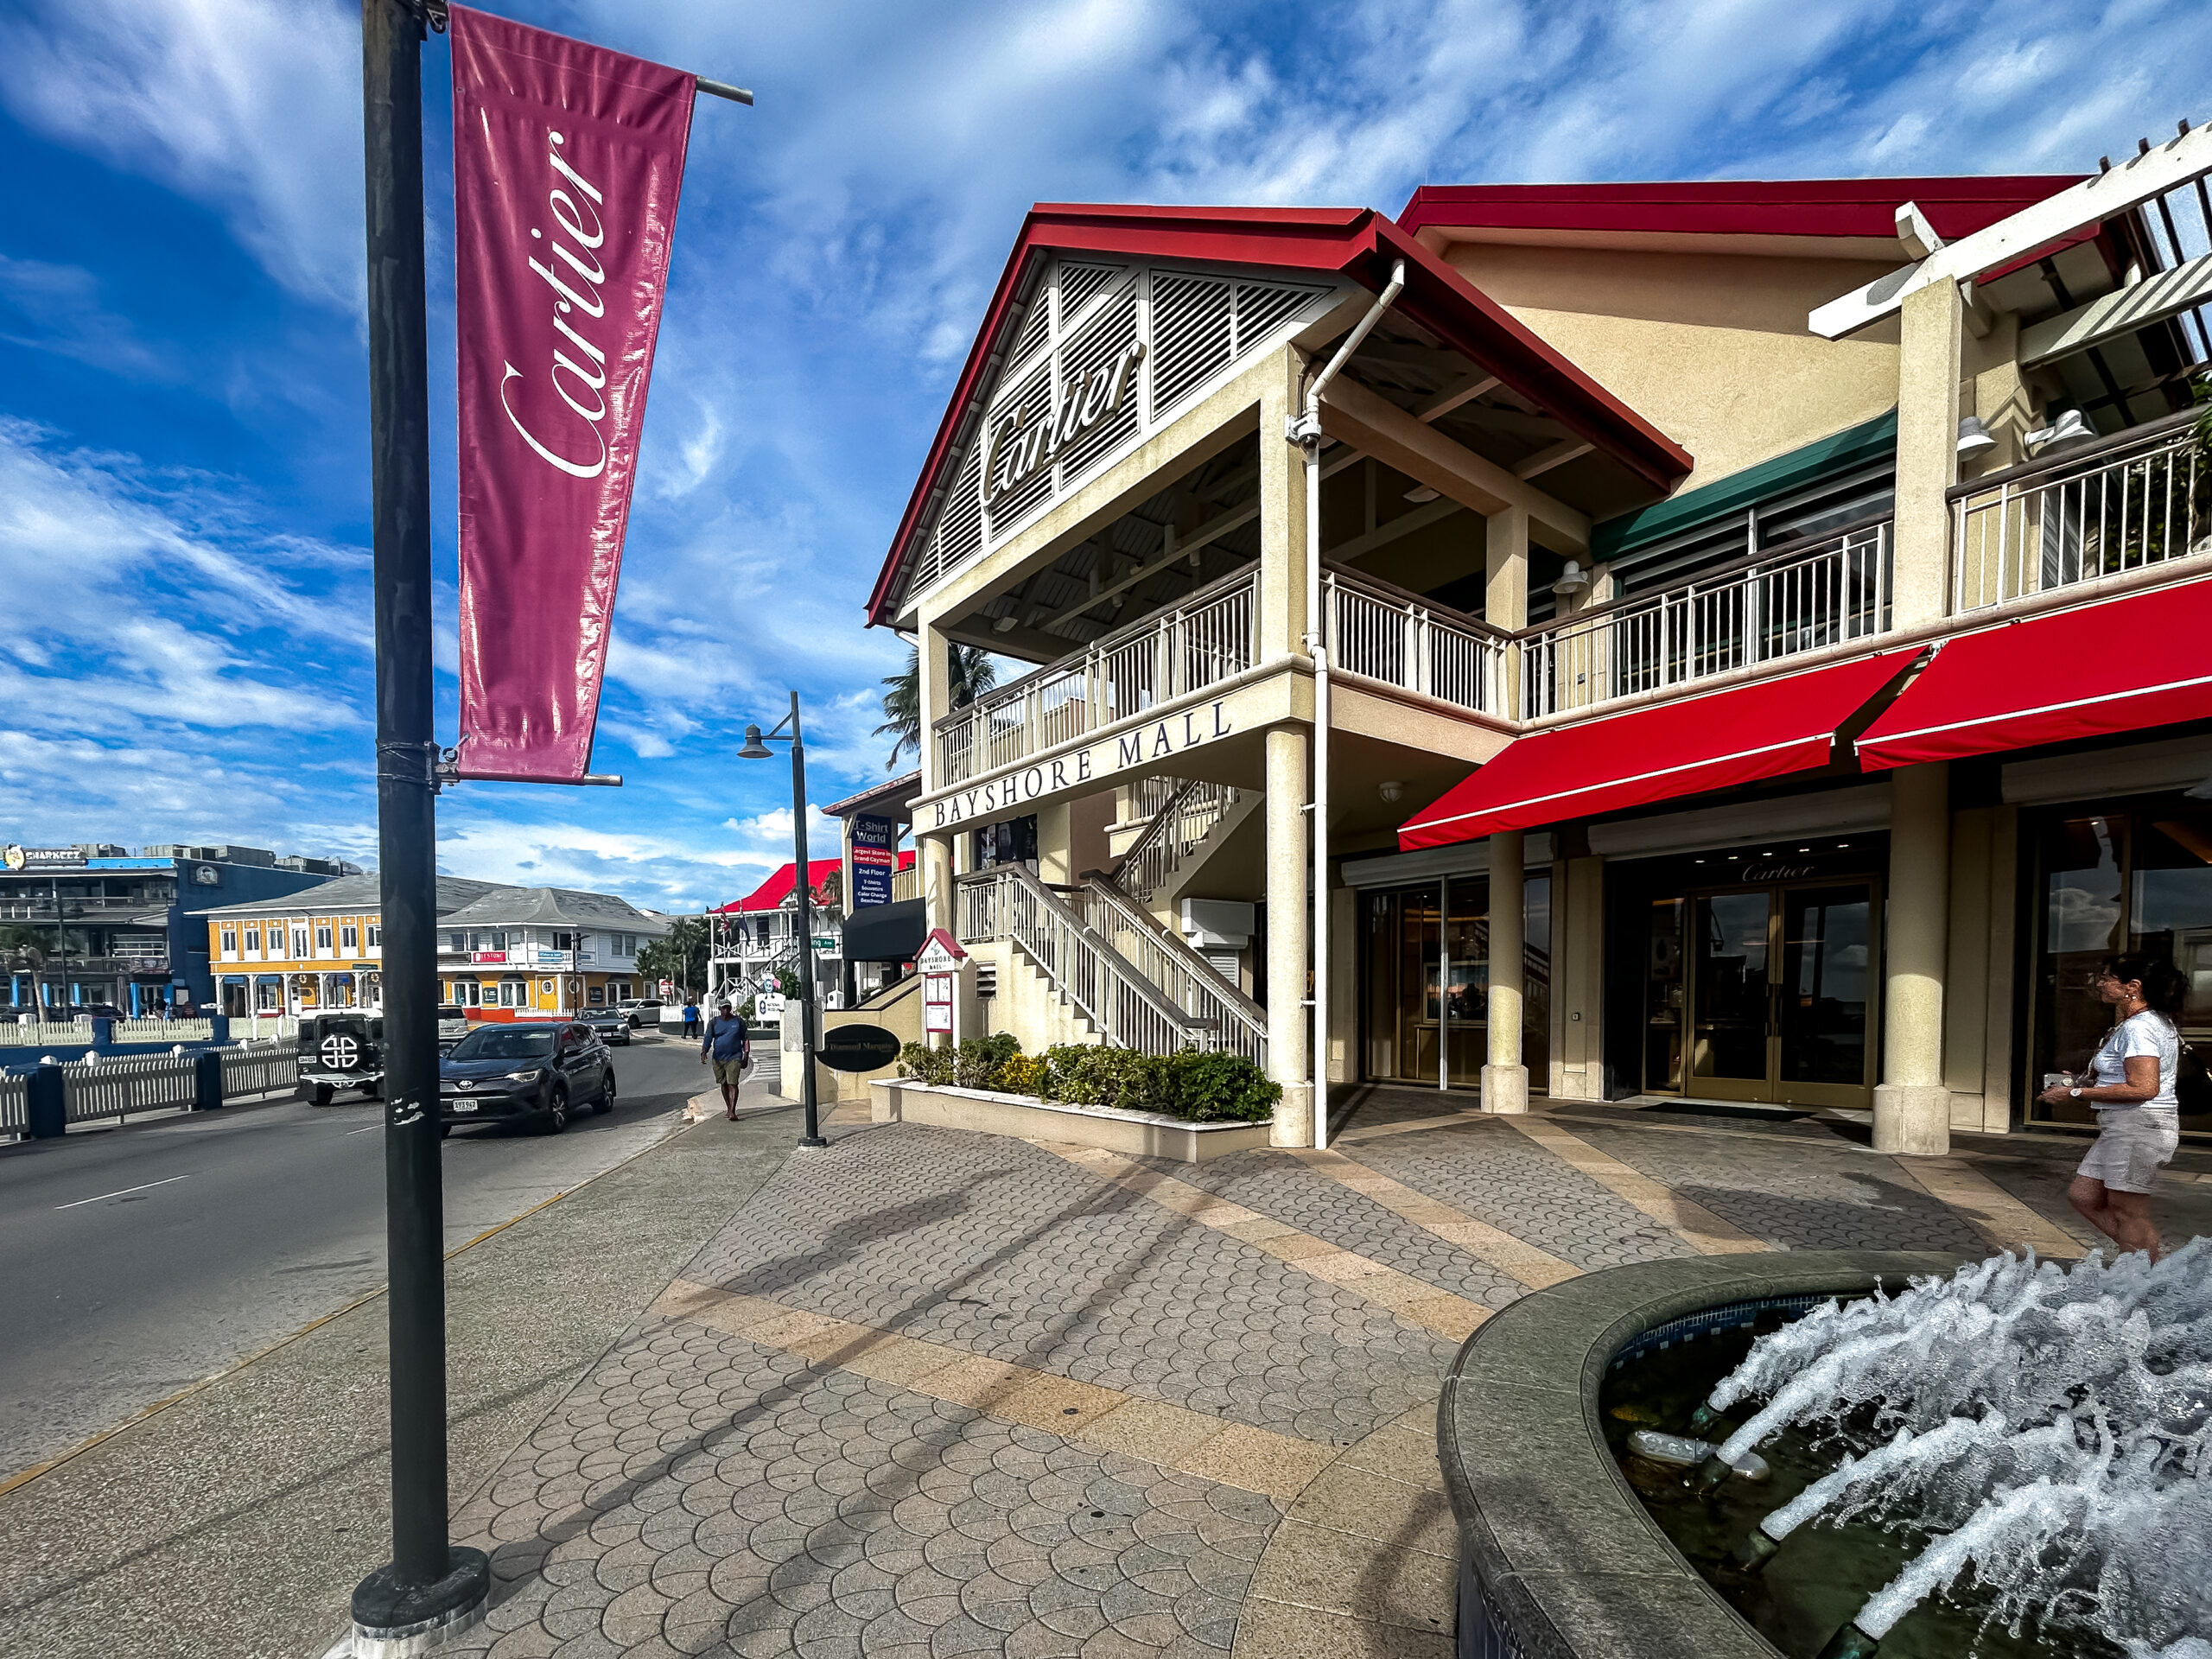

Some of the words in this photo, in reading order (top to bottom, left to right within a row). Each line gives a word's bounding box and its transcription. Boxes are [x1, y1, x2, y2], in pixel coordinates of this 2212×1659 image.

[500, 130, 606, 478] Cartier
[978, 340, 1145, 508] Cartier
[934, 749, 1092, 828] BAYSHORE
[1117, 701, 1231, 768] MALL
[855, 820, 888, 834] T-Shirt
[856, 830, 886, 843] World
[1742, 863, 1815, 882] Cartier
[919, 955, 951, 965] BAYSHORE
